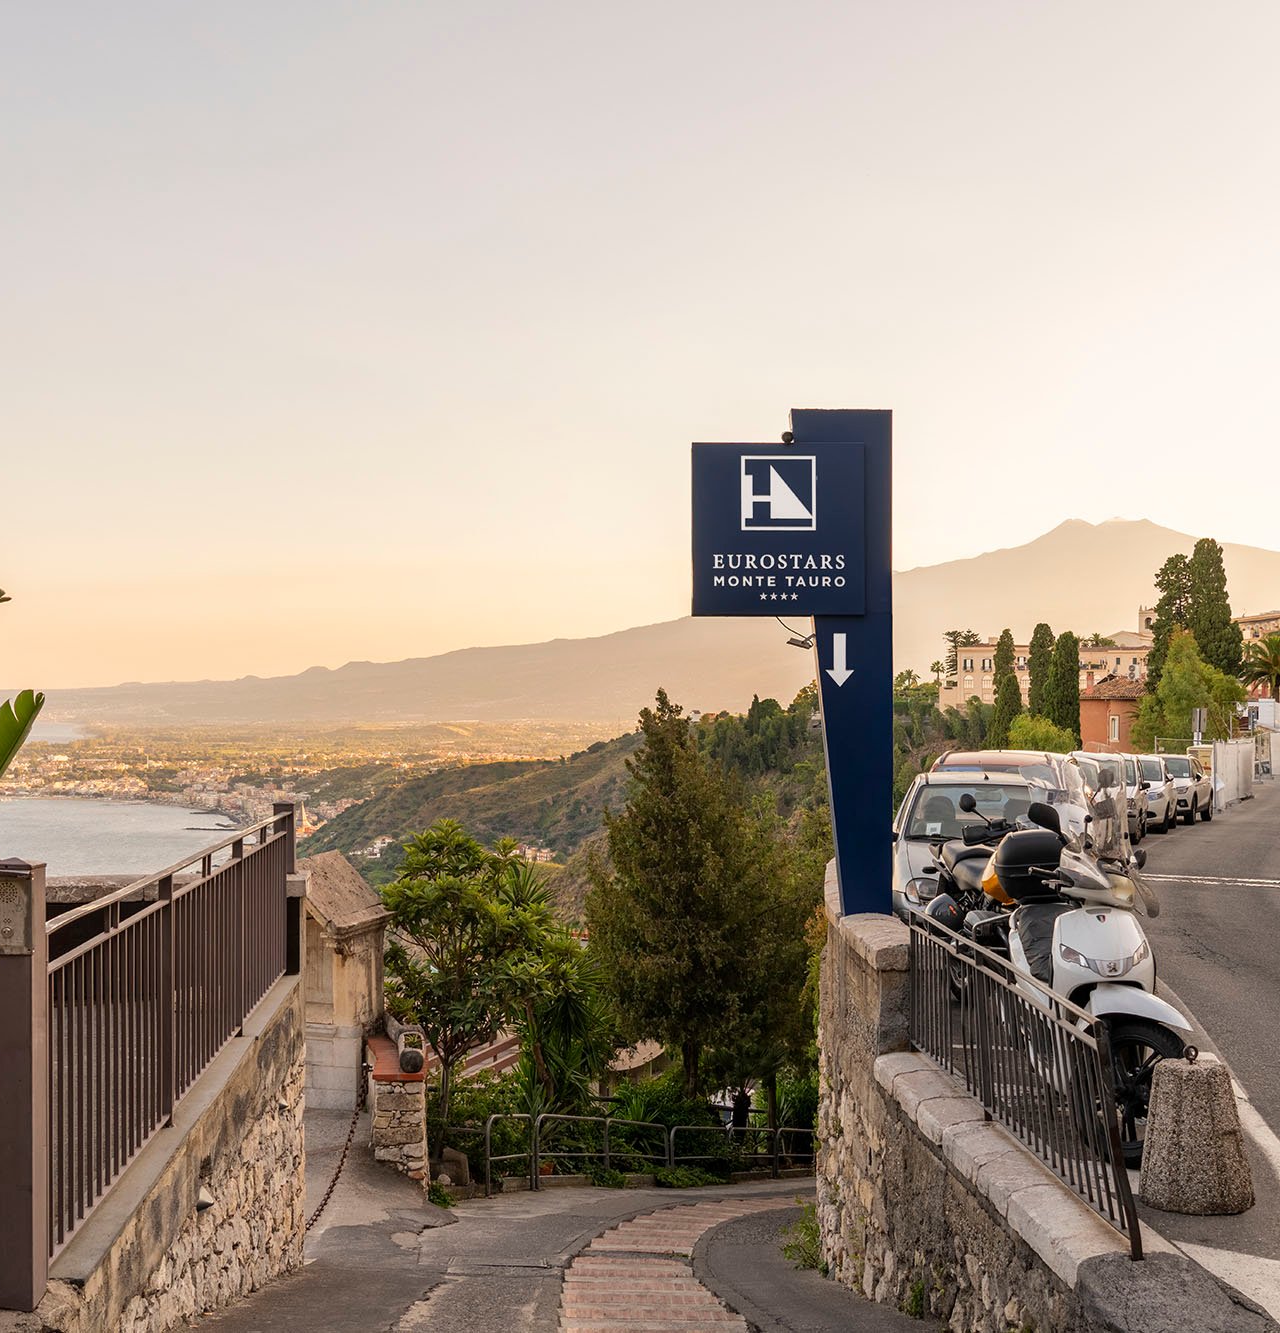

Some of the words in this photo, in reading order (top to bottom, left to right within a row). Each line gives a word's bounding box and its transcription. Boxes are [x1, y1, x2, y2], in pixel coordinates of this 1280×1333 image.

[713, 554, 846, 569] EUROSTARS
[713, 575, 776, 587] MONTE
[785, 575, 846, 587] TAURO
